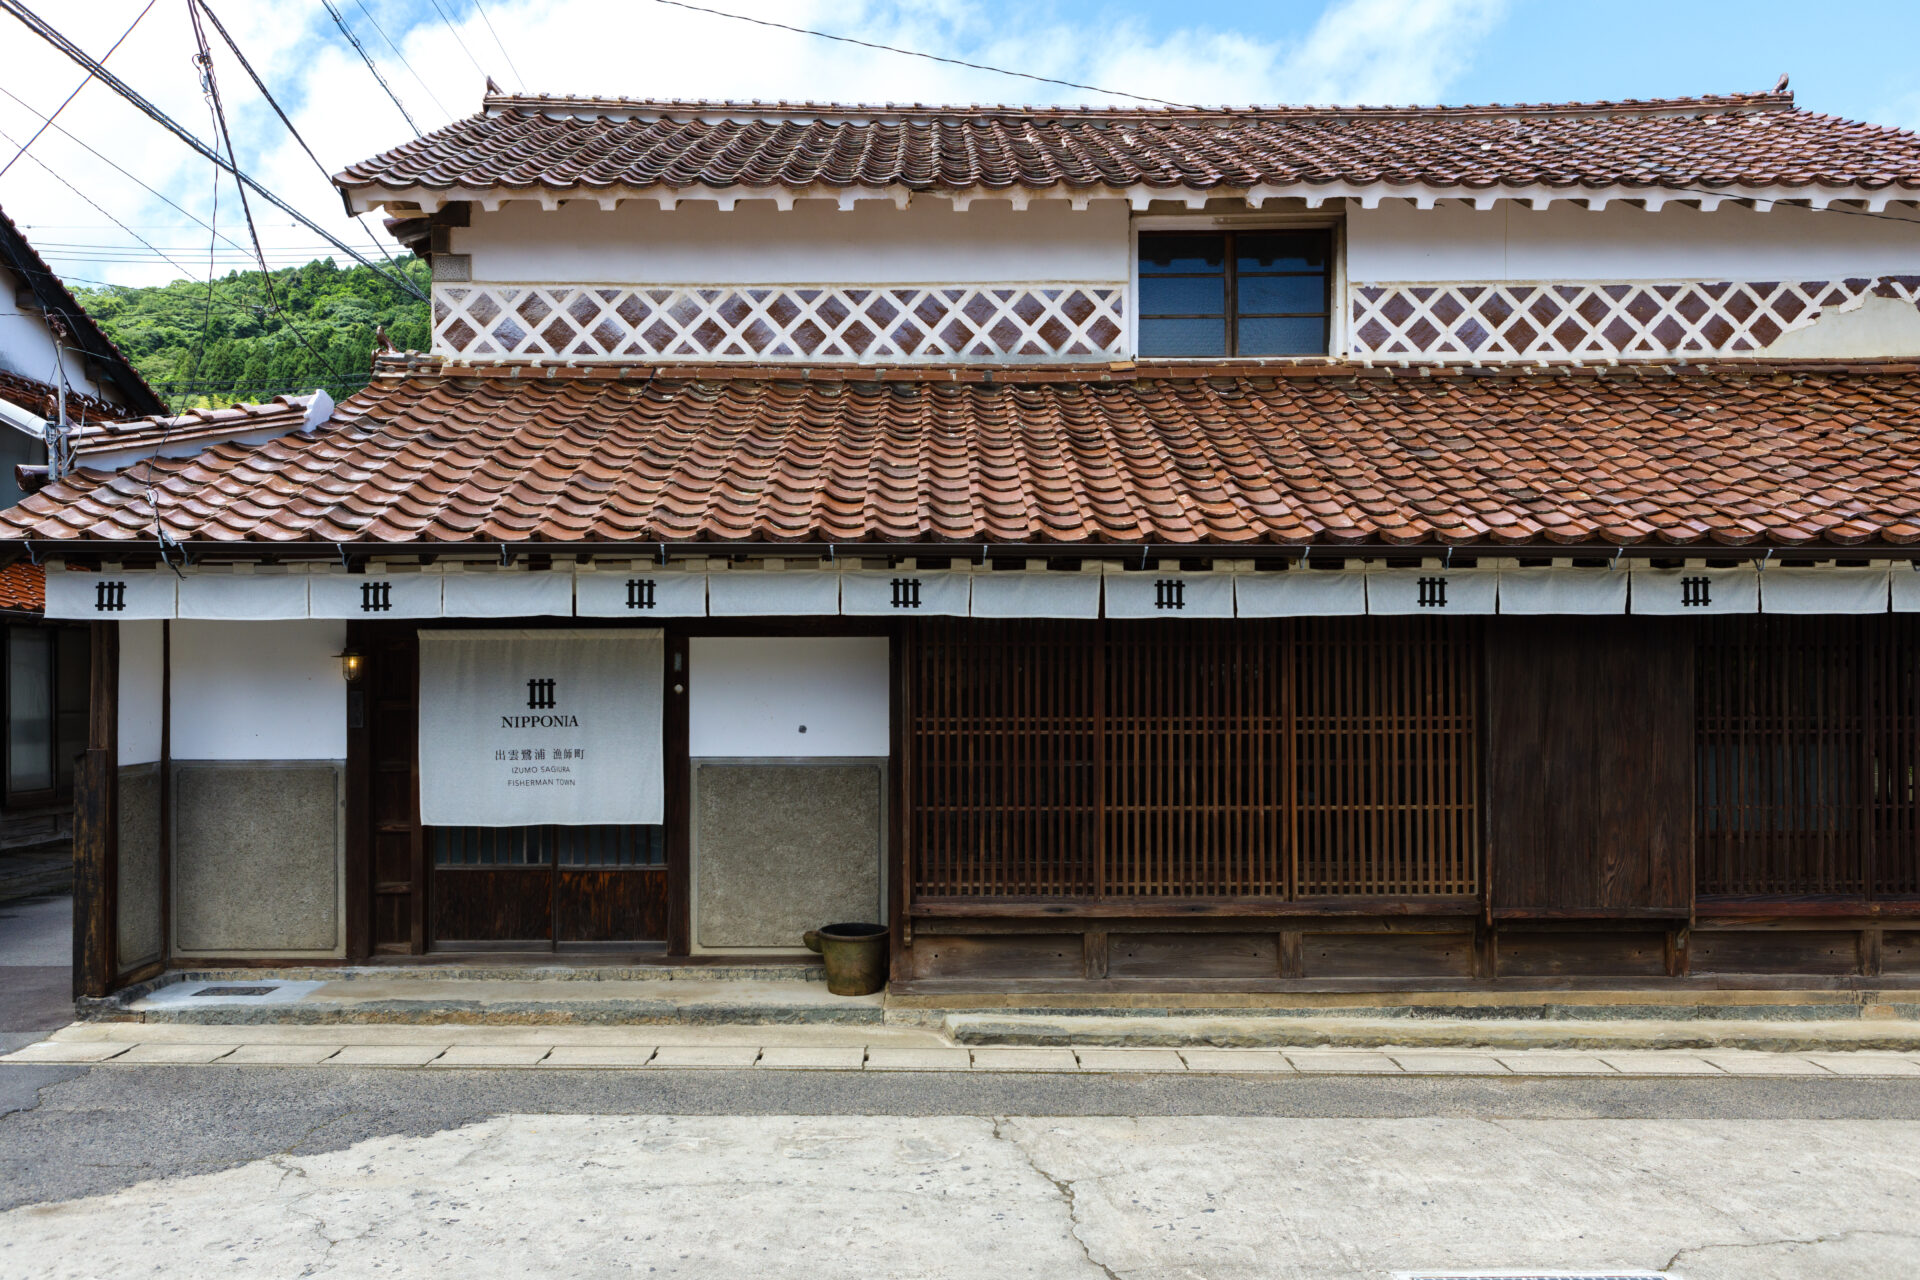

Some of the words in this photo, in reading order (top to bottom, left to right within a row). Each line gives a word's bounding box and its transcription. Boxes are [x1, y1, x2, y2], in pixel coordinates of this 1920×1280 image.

[501, 715, 579, 728] NIPPONIA
[553, 747, 585, 760] 漁師町
[511, 766, 538, 774] IZUMO
[540, 765, 571, 773] SAGIURA
[507, 779, 554, 787] FISHERMAN
[556, 778, 576, 786] TOWN
